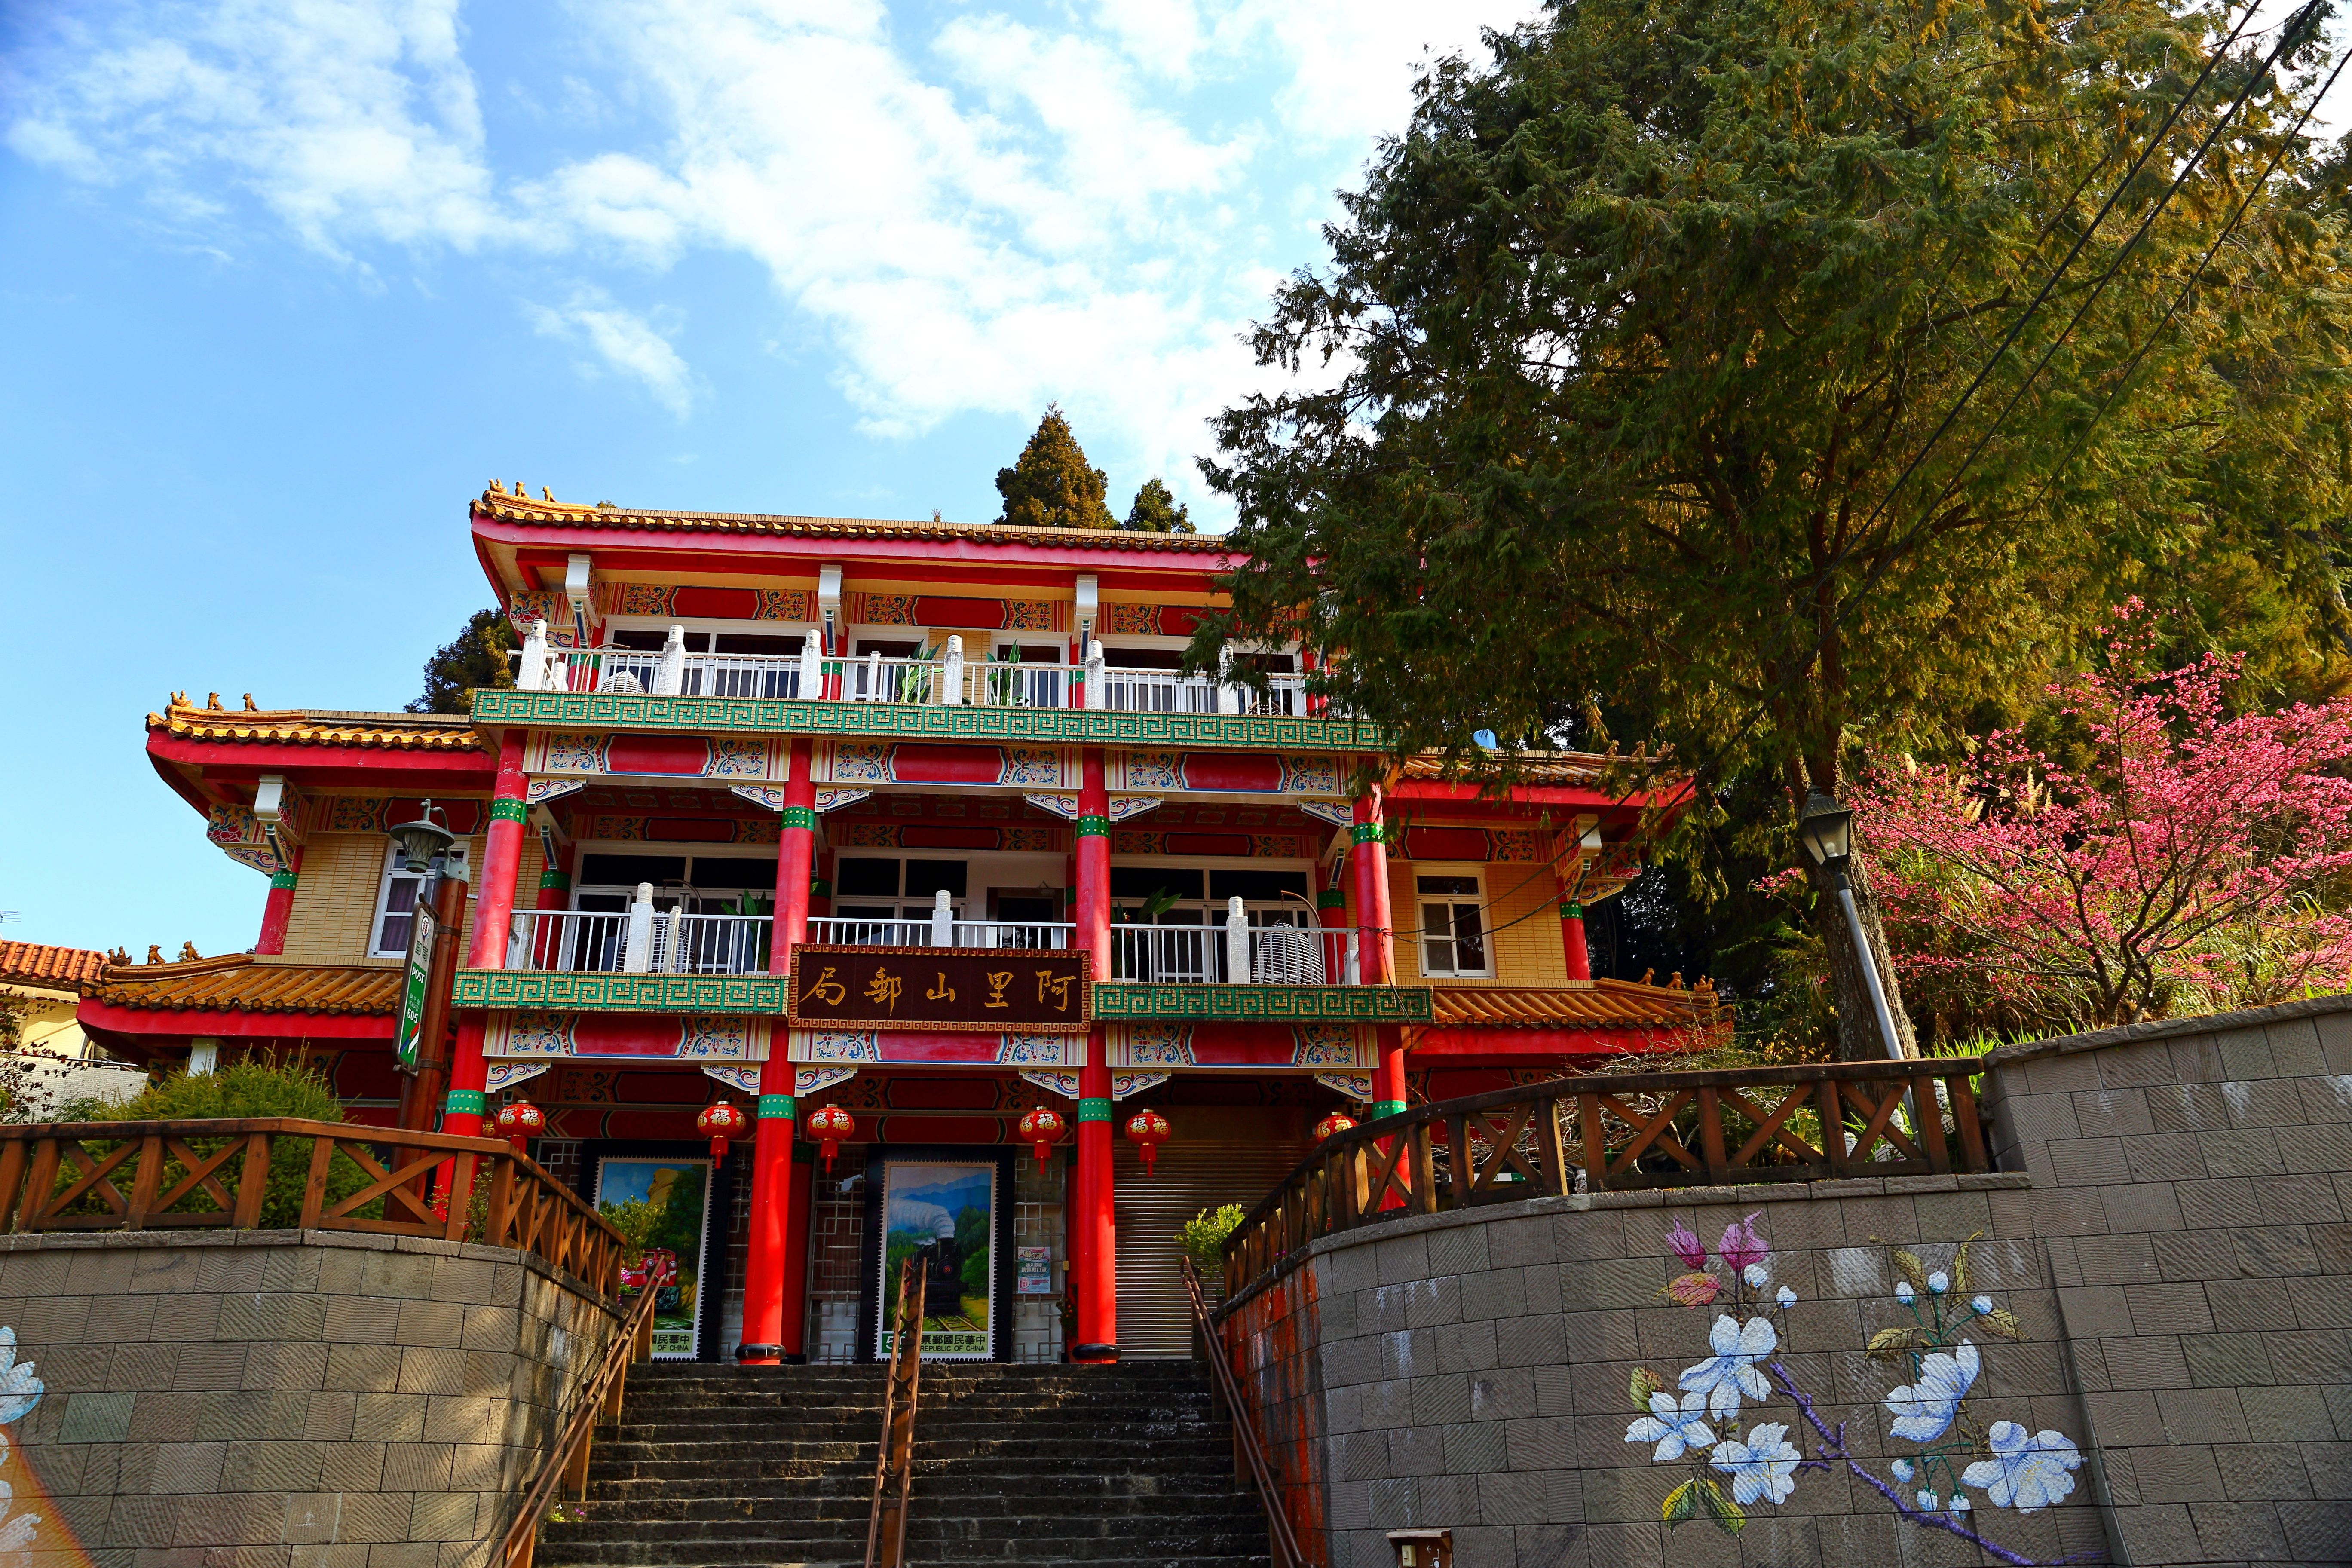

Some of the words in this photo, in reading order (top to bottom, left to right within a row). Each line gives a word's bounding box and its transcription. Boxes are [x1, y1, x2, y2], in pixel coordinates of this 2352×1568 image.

[411, 966, 425, 983] POST
[799, 967, 1076, 1016] 阿里山郵局
[407, 1008, 418, 1023] 605
[499, 1108, 516, 1125] 福
[521, 1109, 540, 1127] 福
[710, 1109, 731, 1126] 福
[811, 1112, 829, 1129] 福
[832, 1112, 850, 1131] 福
[1037, 1113, 1057, 1130] 福
[1130, 1116, 1149, 1134] 福
[1153, 1118, 1169, 1135] 福
[921, 1335, 985, 1345] 中華民國郵票
